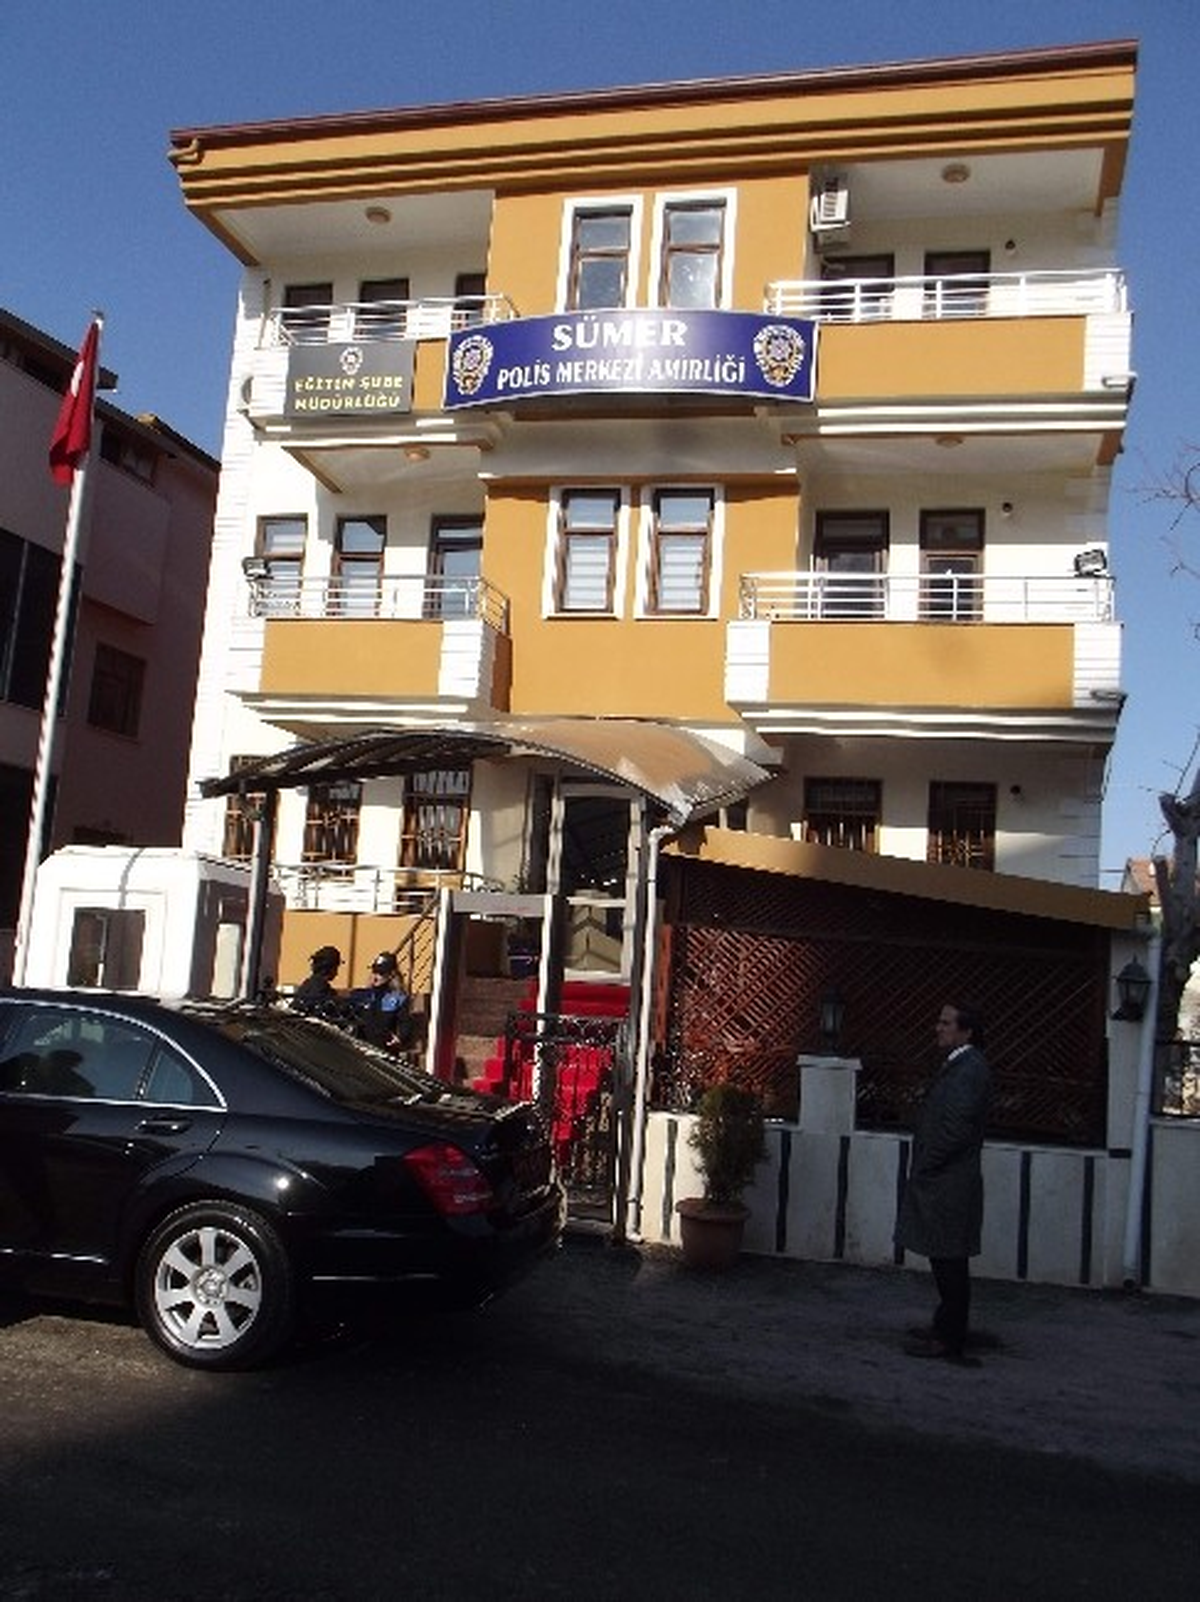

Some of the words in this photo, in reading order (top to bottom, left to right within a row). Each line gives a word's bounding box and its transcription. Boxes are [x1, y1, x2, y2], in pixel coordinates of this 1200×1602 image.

[551, 316, 688, 351] SÜMER
[497, 359, 551, 391] POLİS
[556, 353, 643, 384] MERKEZİ
[647, 355, 746, 384] AMİRLİĞİ
